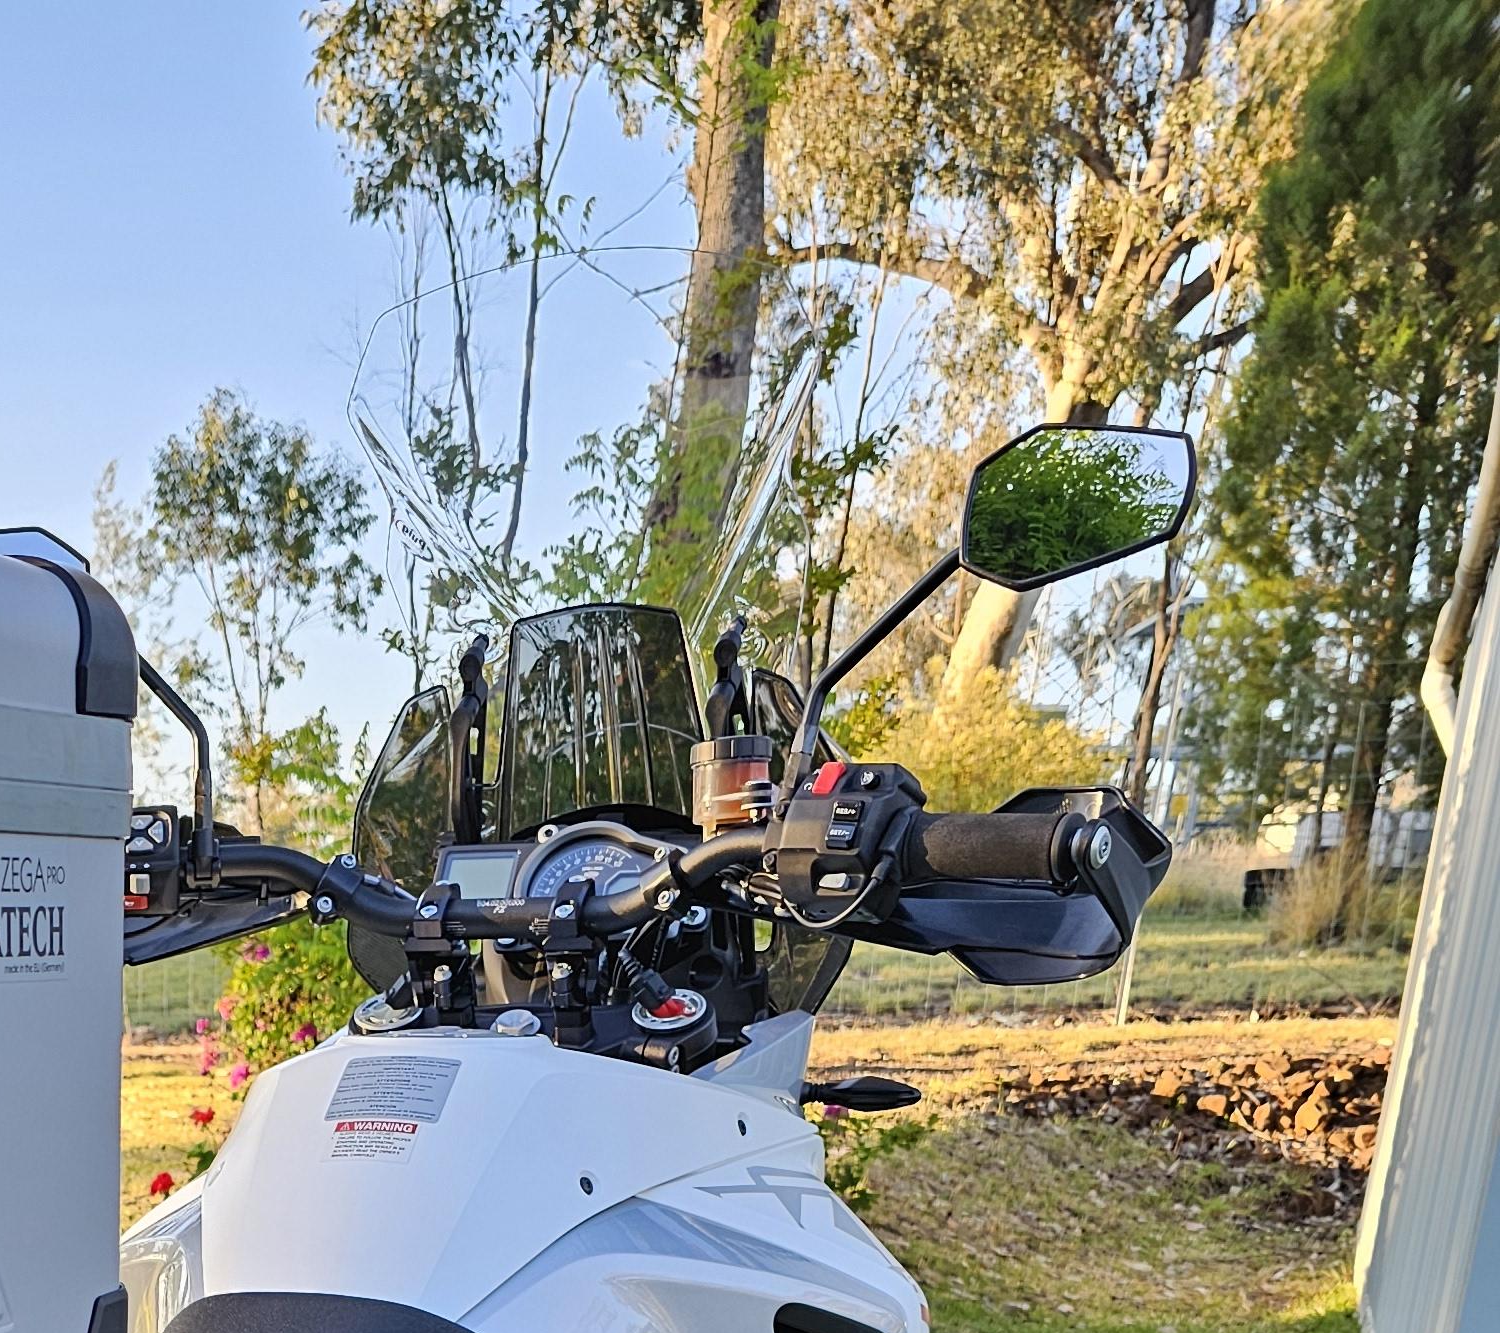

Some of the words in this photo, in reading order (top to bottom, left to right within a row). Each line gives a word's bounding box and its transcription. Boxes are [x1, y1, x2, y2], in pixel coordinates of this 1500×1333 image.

[1, 856, 46, 893] ZEGA
[47, 865, 66, 885] PRO
[353, 1121, 414, 1133] WARNING
